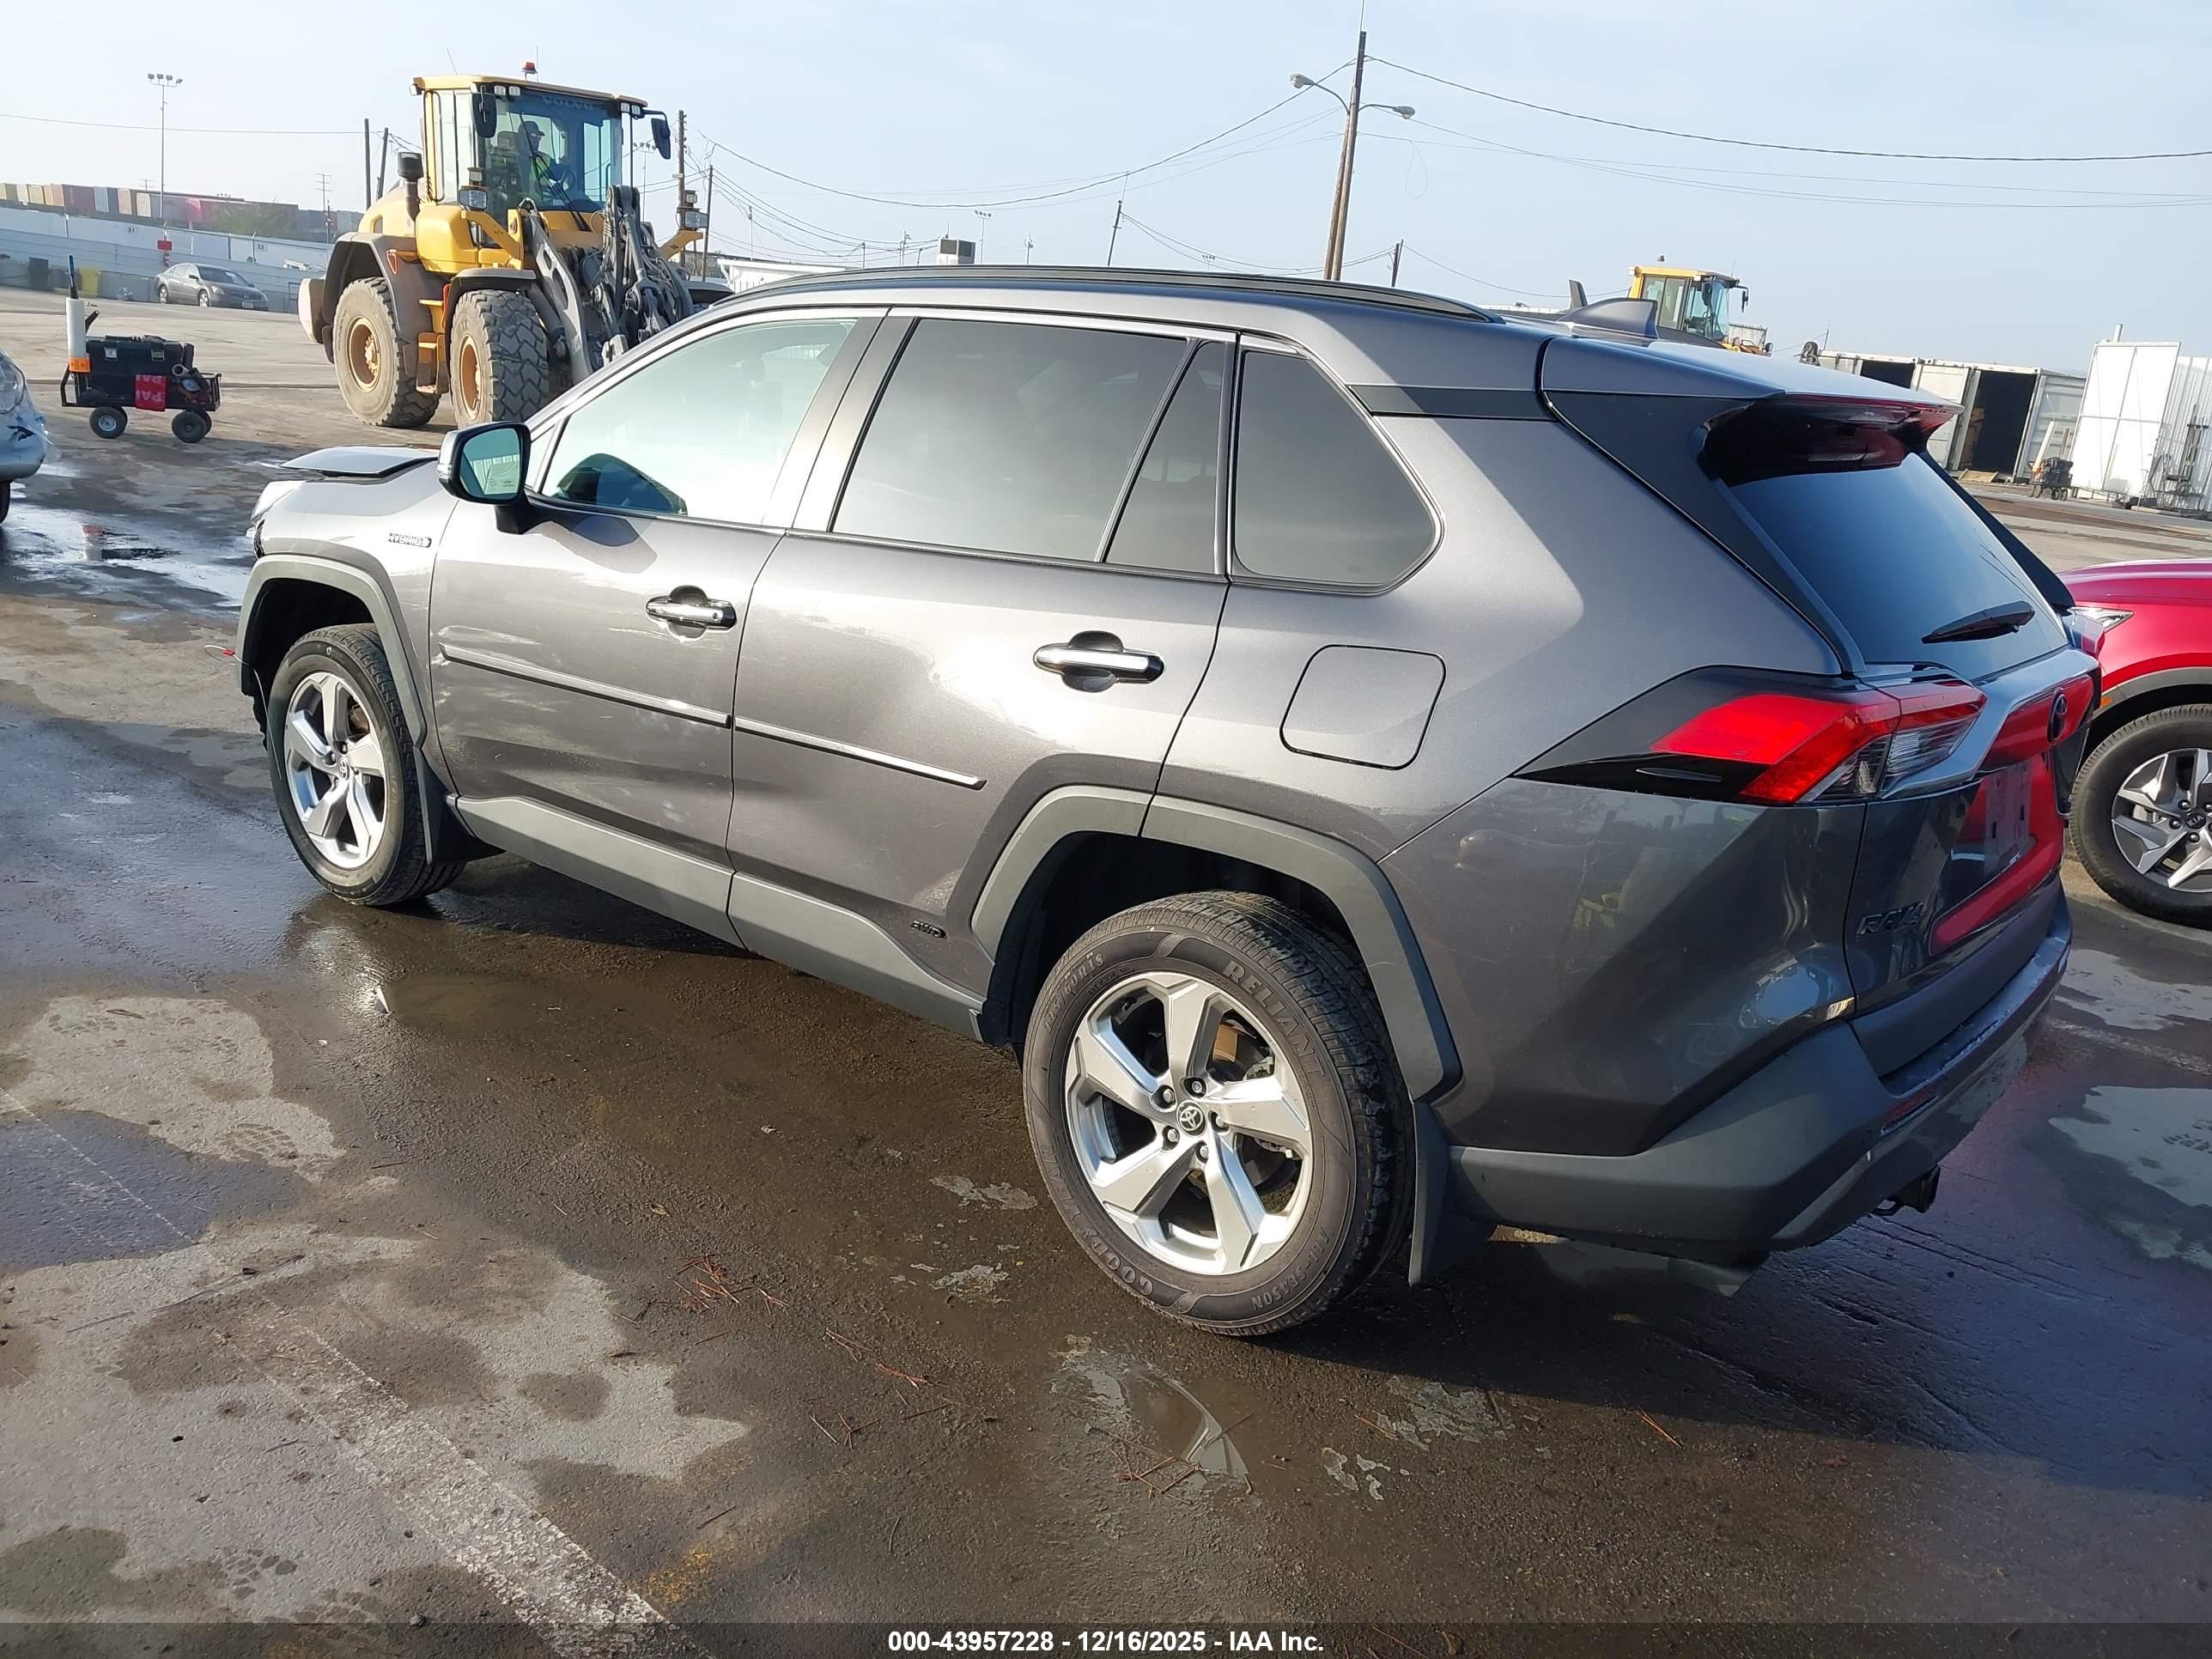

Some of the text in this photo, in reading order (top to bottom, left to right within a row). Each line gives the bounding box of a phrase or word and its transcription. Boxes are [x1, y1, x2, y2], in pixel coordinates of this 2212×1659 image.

[544, 95, 592, 110] VOLVO
[2186, 815, 2204, 827] KIA
[1856, 902, 1923, 935] RAV4
[1223, 951, 1326, 1077] RELIANT
